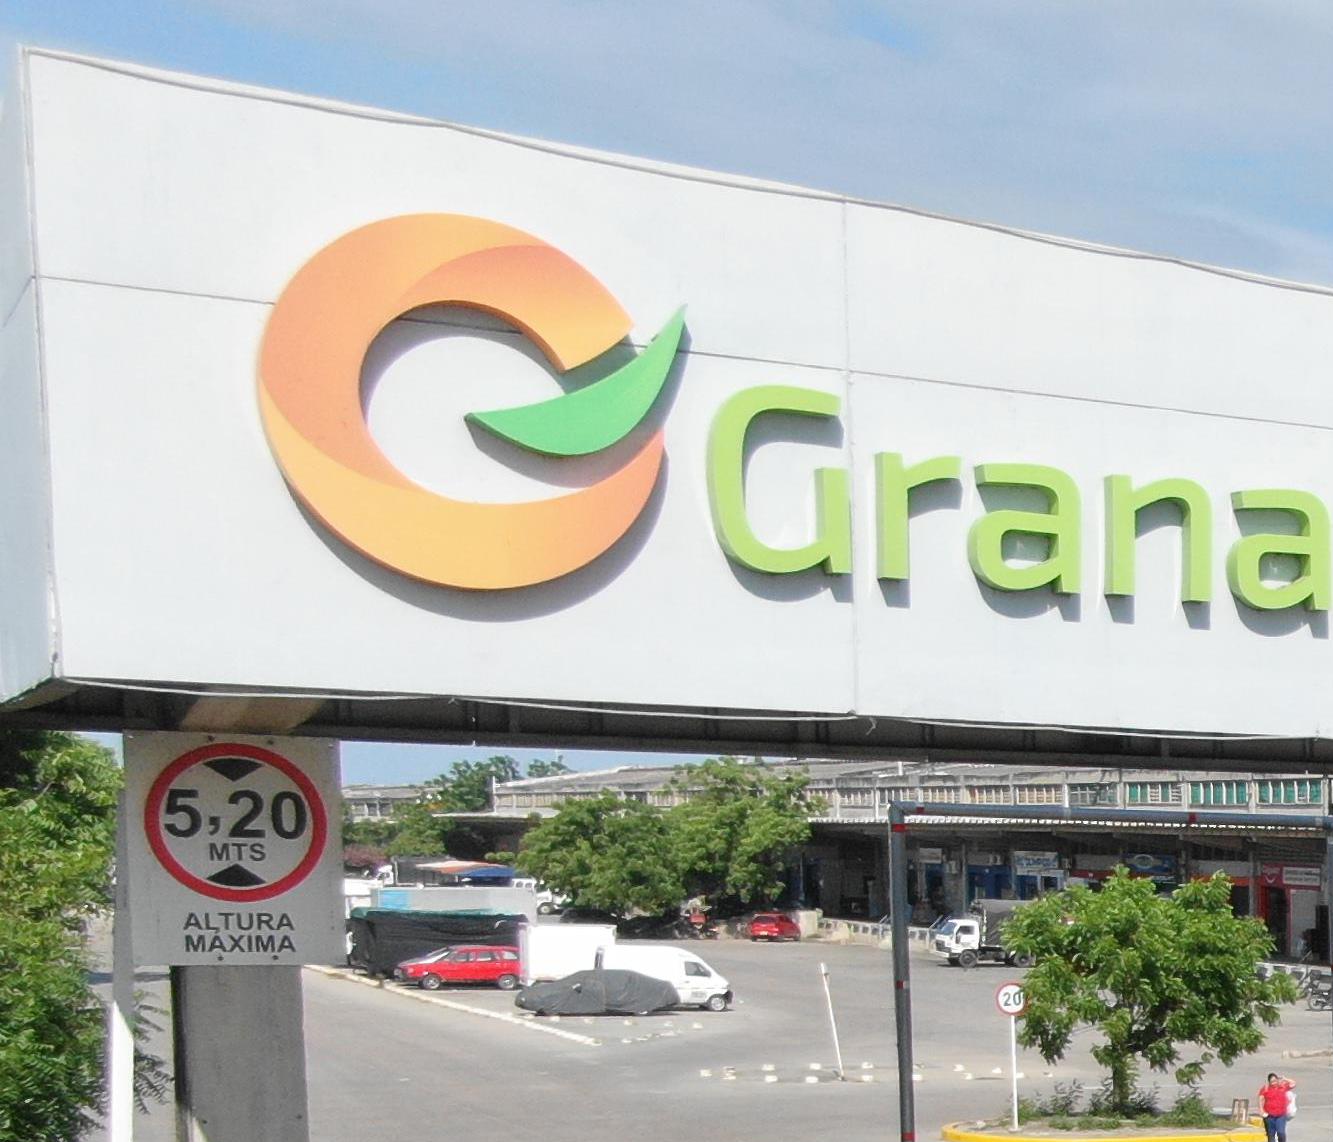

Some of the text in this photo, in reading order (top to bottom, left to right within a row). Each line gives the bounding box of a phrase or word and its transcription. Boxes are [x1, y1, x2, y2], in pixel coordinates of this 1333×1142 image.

[164, 788, 307, 839] 5,20
[209, 843, 267, 862] MTS
[183, 912, 295, 931] ALTURA
[184, 930, 296, 953] MÁXIMA
[1003, 991, 1021, 1007] 20
